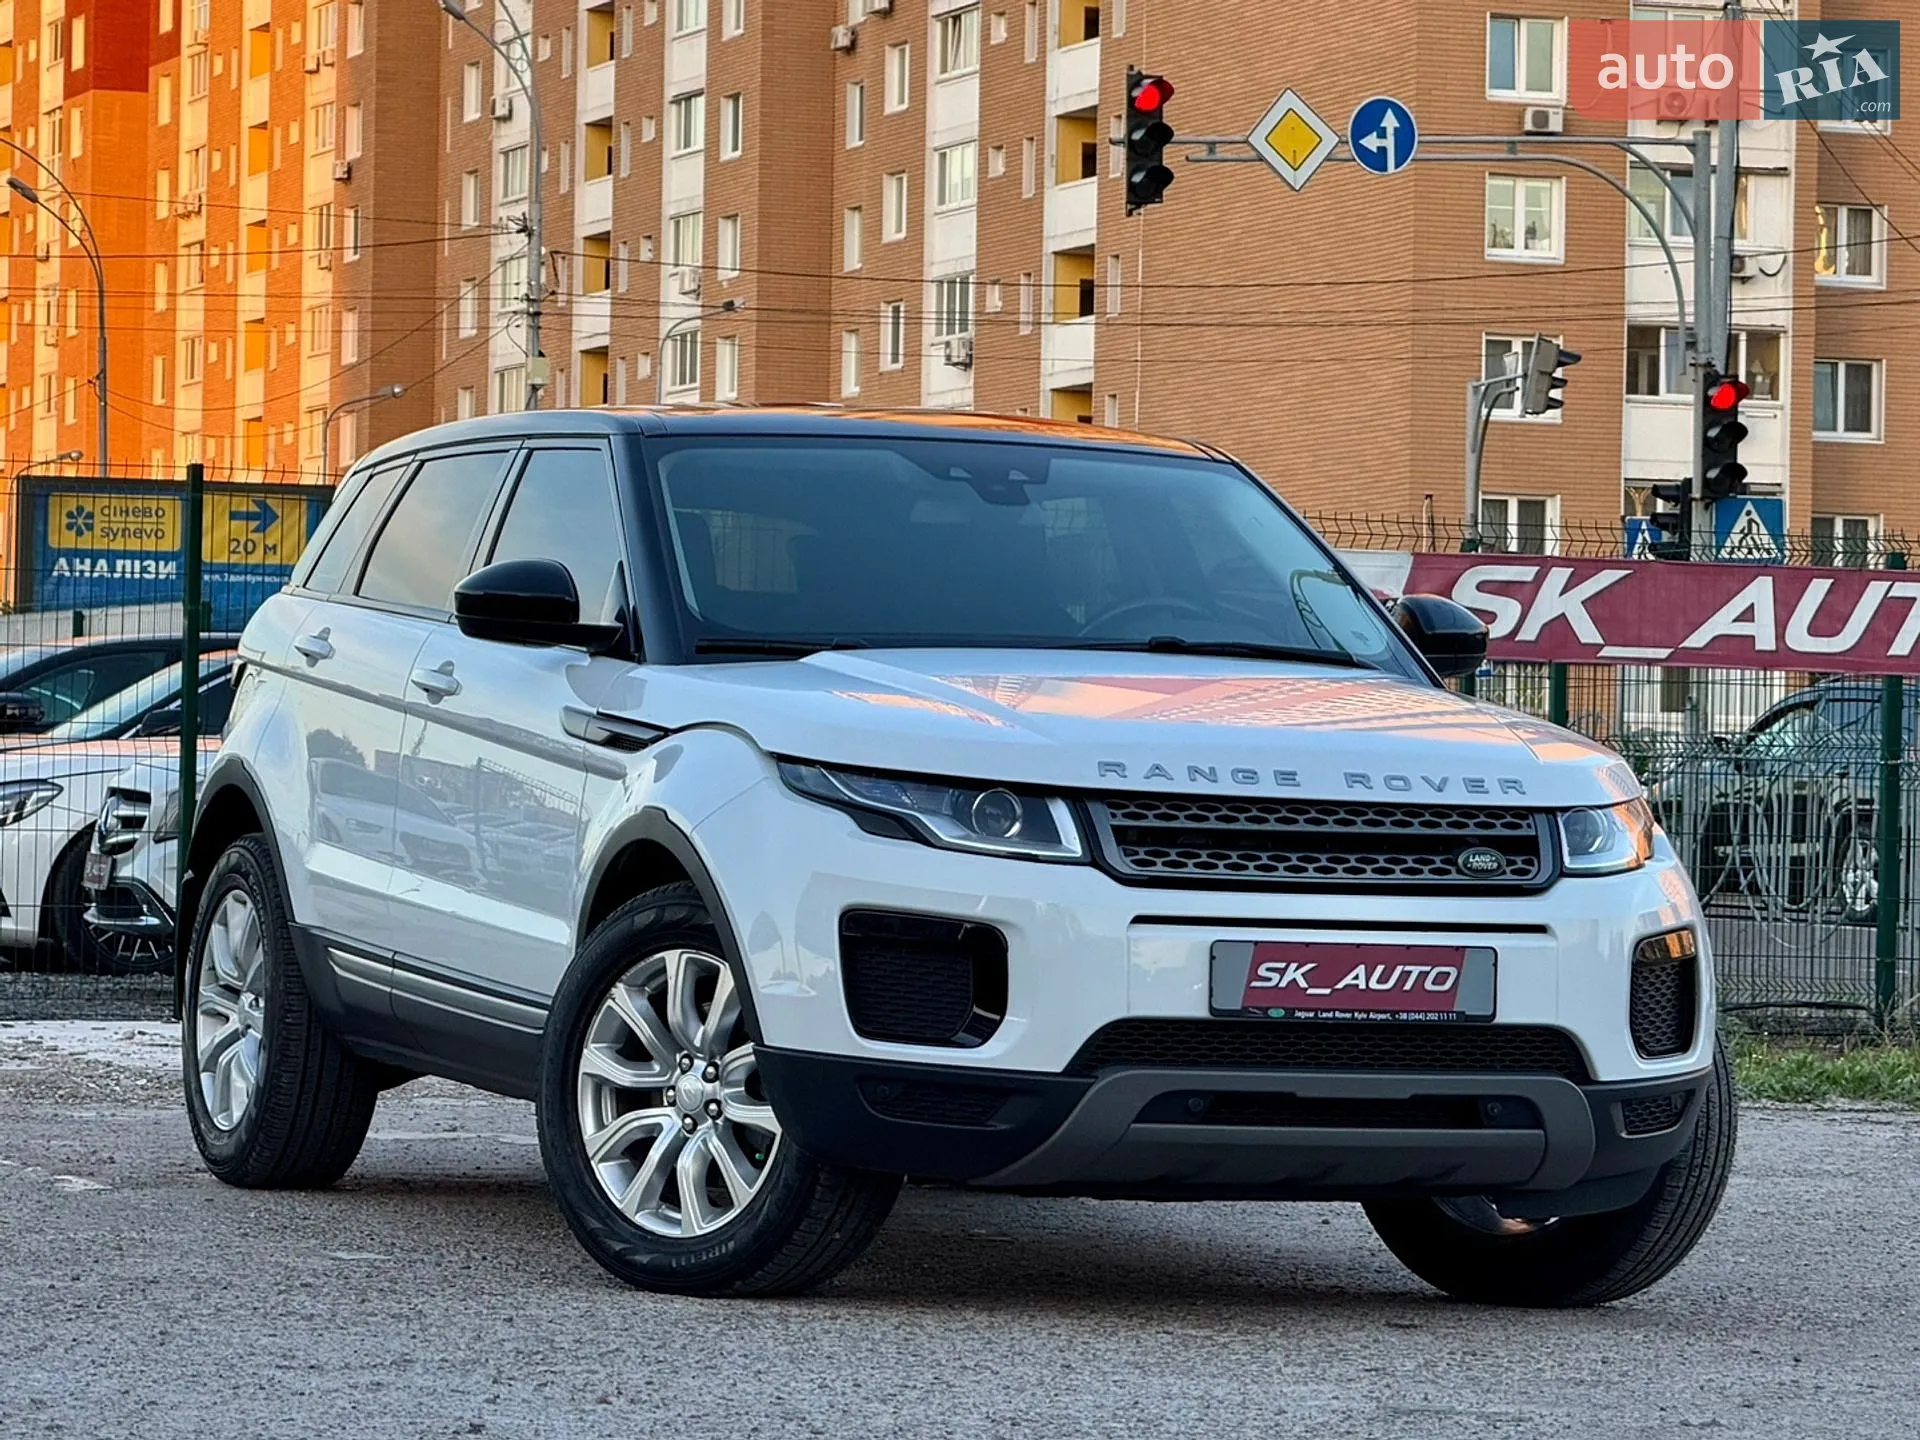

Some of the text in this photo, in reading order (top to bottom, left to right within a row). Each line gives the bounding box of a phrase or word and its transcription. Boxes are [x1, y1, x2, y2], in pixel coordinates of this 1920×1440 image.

[100, 504, 166, 519] сінево
[100, 527, 165, 542] synevo
[230, 538, 257, 555] 20
[51, 556, 176, 580] АНАЛІЗИ
[1097, 760, 1526, 795] RANGE ROVER
[1469, 854, 1491, 862] LAND
[1472, 862, 1498, 870] ROVER
[1249, 962, 1458, 995] SK_AUTO
[1294, 1010, 1315, 1019] Jaguar
[1318, 1010, 1334, 1018] Land
[1426, 1012, 1439, 1020] 202
[1449, 1013, 1456, 1021] 11
